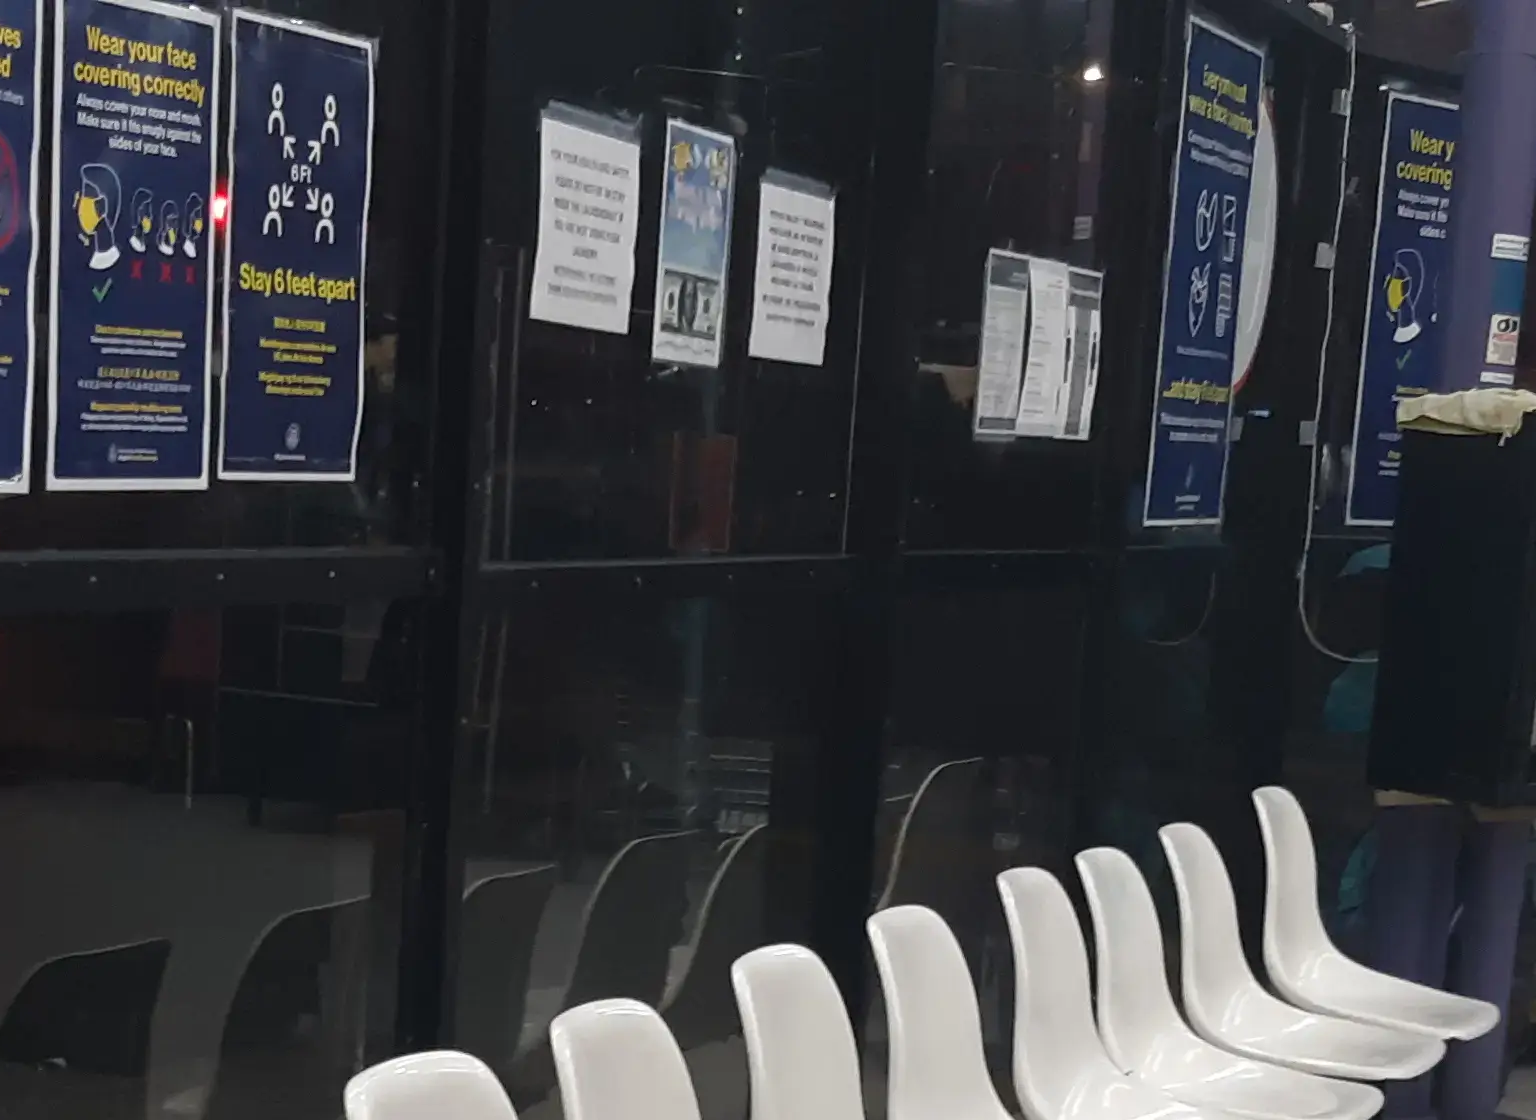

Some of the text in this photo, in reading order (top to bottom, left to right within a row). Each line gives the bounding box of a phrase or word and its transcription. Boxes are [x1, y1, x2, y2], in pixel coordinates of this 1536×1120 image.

[86, 25, 197, 71] Wear your face
[73, 61, 205, 109] covering correctly
[1410, 128, 1444, 156] Wear
[290, 164, 299, 182] 6
[1396, 160, 1453, 191] covering
[239, 262, 356, 304] Stay 6 feet apart
